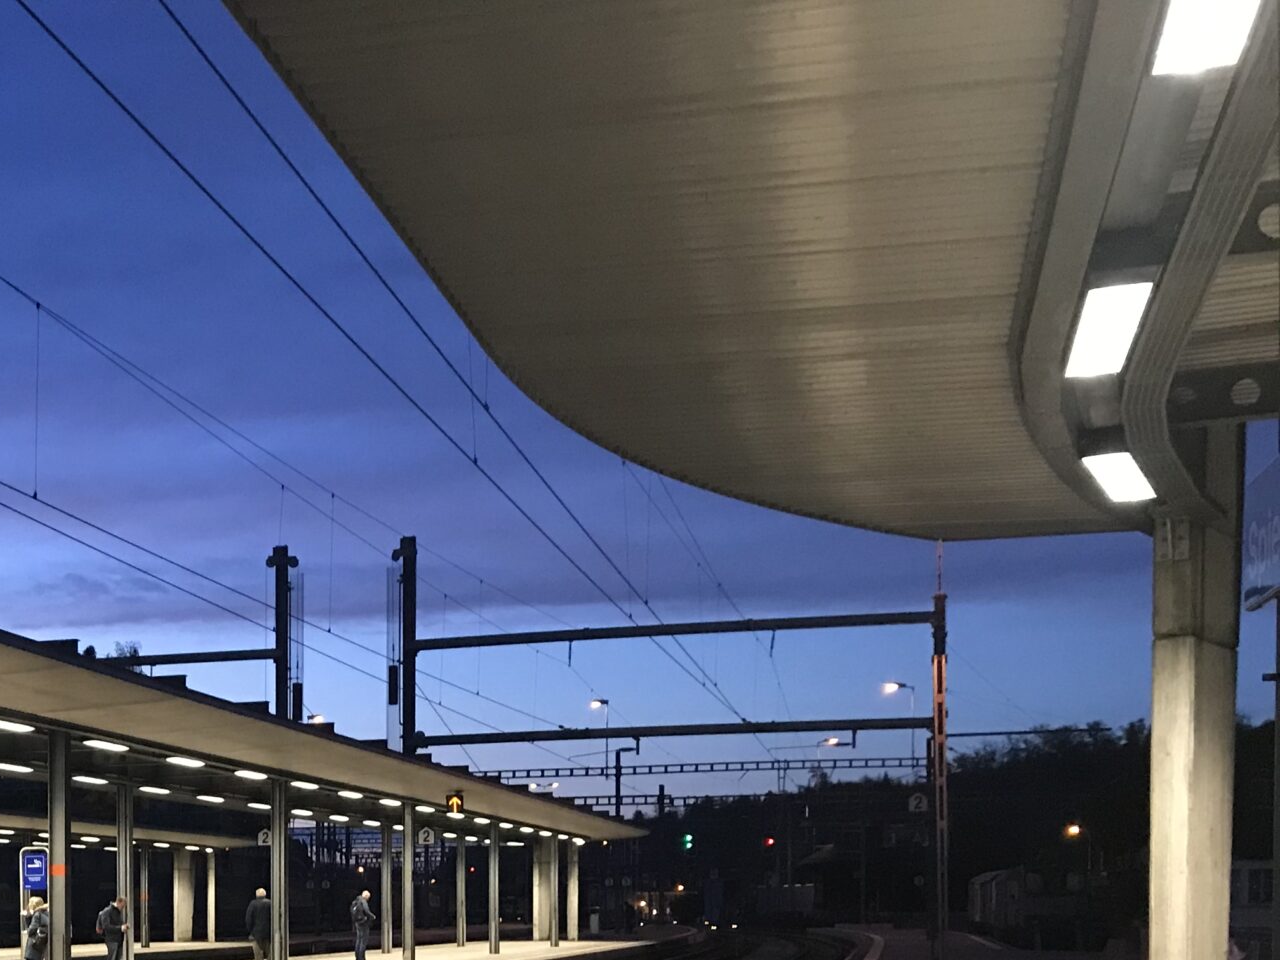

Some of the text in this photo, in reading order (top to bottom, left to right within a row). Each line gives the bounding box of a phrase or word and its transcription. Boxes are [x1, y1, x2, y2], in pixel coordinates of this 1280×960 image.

[914, 796, 922, 809] 2
[262, 832, 269, 843] 2
[423, 830, 431, 842] 2
